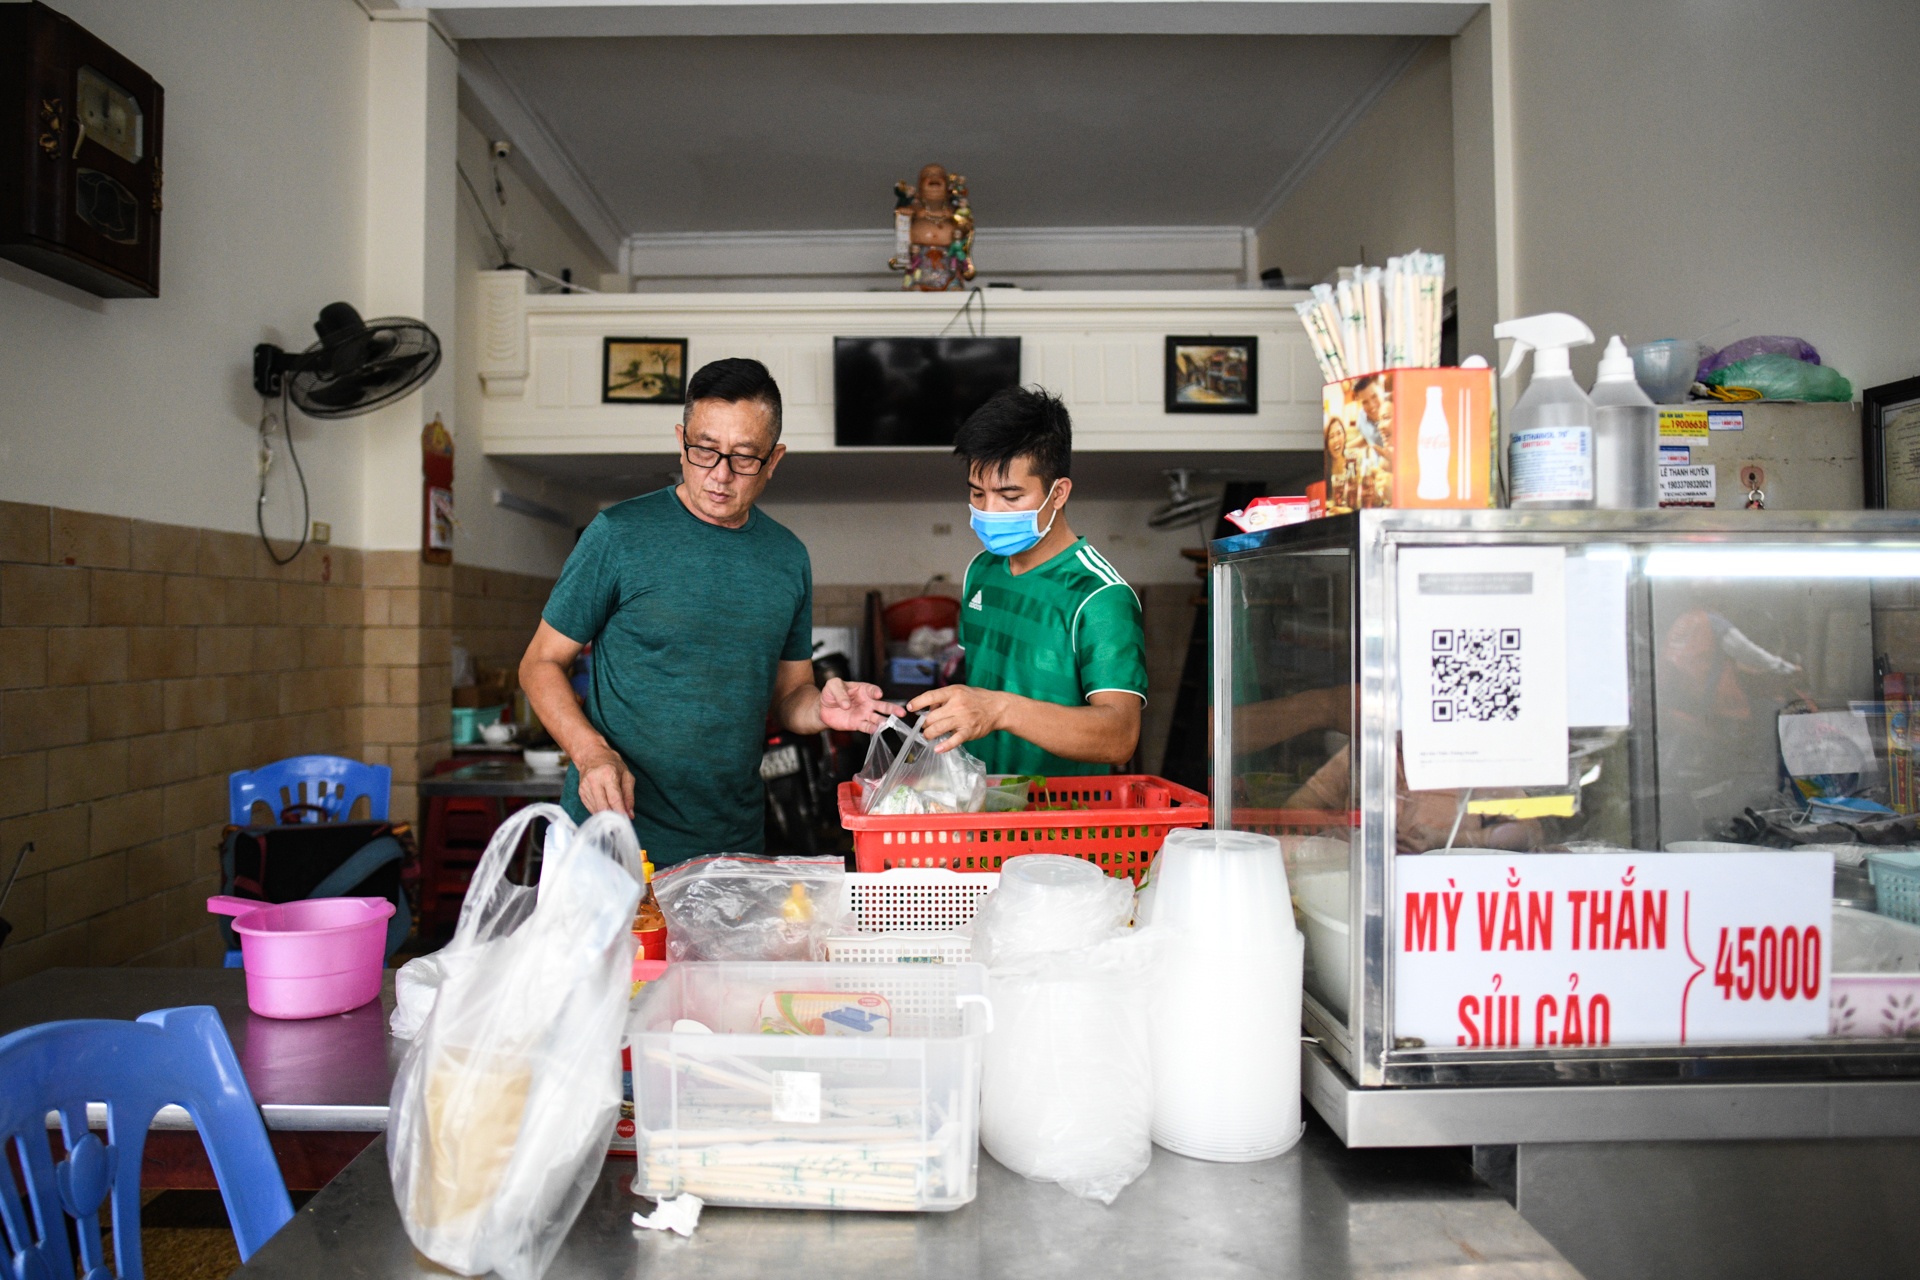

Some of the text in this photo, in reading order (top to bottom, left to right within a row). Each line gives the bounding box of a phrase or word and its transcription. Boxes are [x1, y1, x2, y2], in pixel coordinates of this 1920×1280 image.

[1671, 420, 1707, 429] 19006638
[1669, 468, 1689, 477] THANH
[1403, 865, 1668, 953] MỲ VẰN THẮN
[1713, 925, 1821, 1001] 45000
